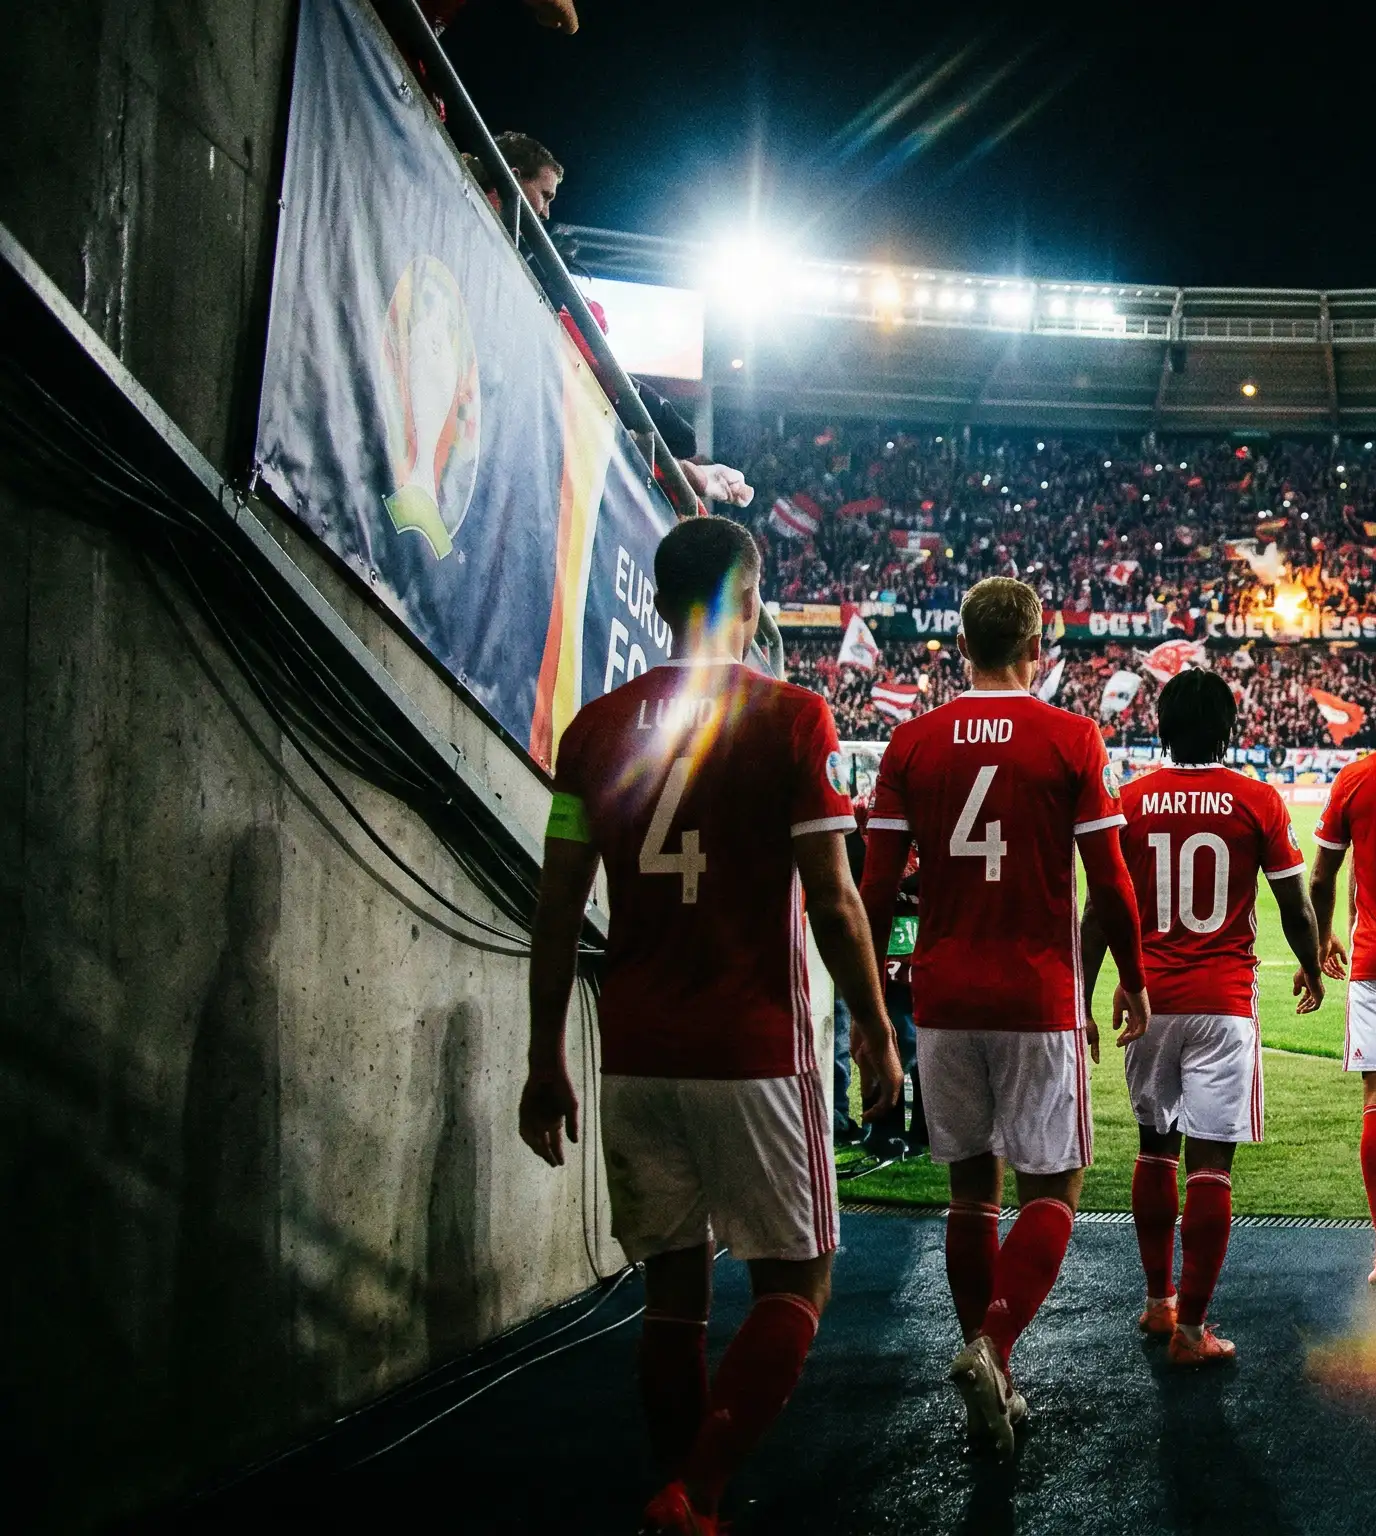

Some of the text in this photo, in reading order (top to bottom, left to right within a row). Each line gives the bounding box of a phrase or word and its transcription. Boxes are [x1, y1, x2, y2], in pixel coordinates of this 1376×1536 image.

[953, 718, 1013, 744] LUND
[639, 757, 706, 904] 4
[950, 765, 1007, 881] 4
[1142, 791, 1234, 816] MARTINS
[1148, 832, 1230, 934] 10
